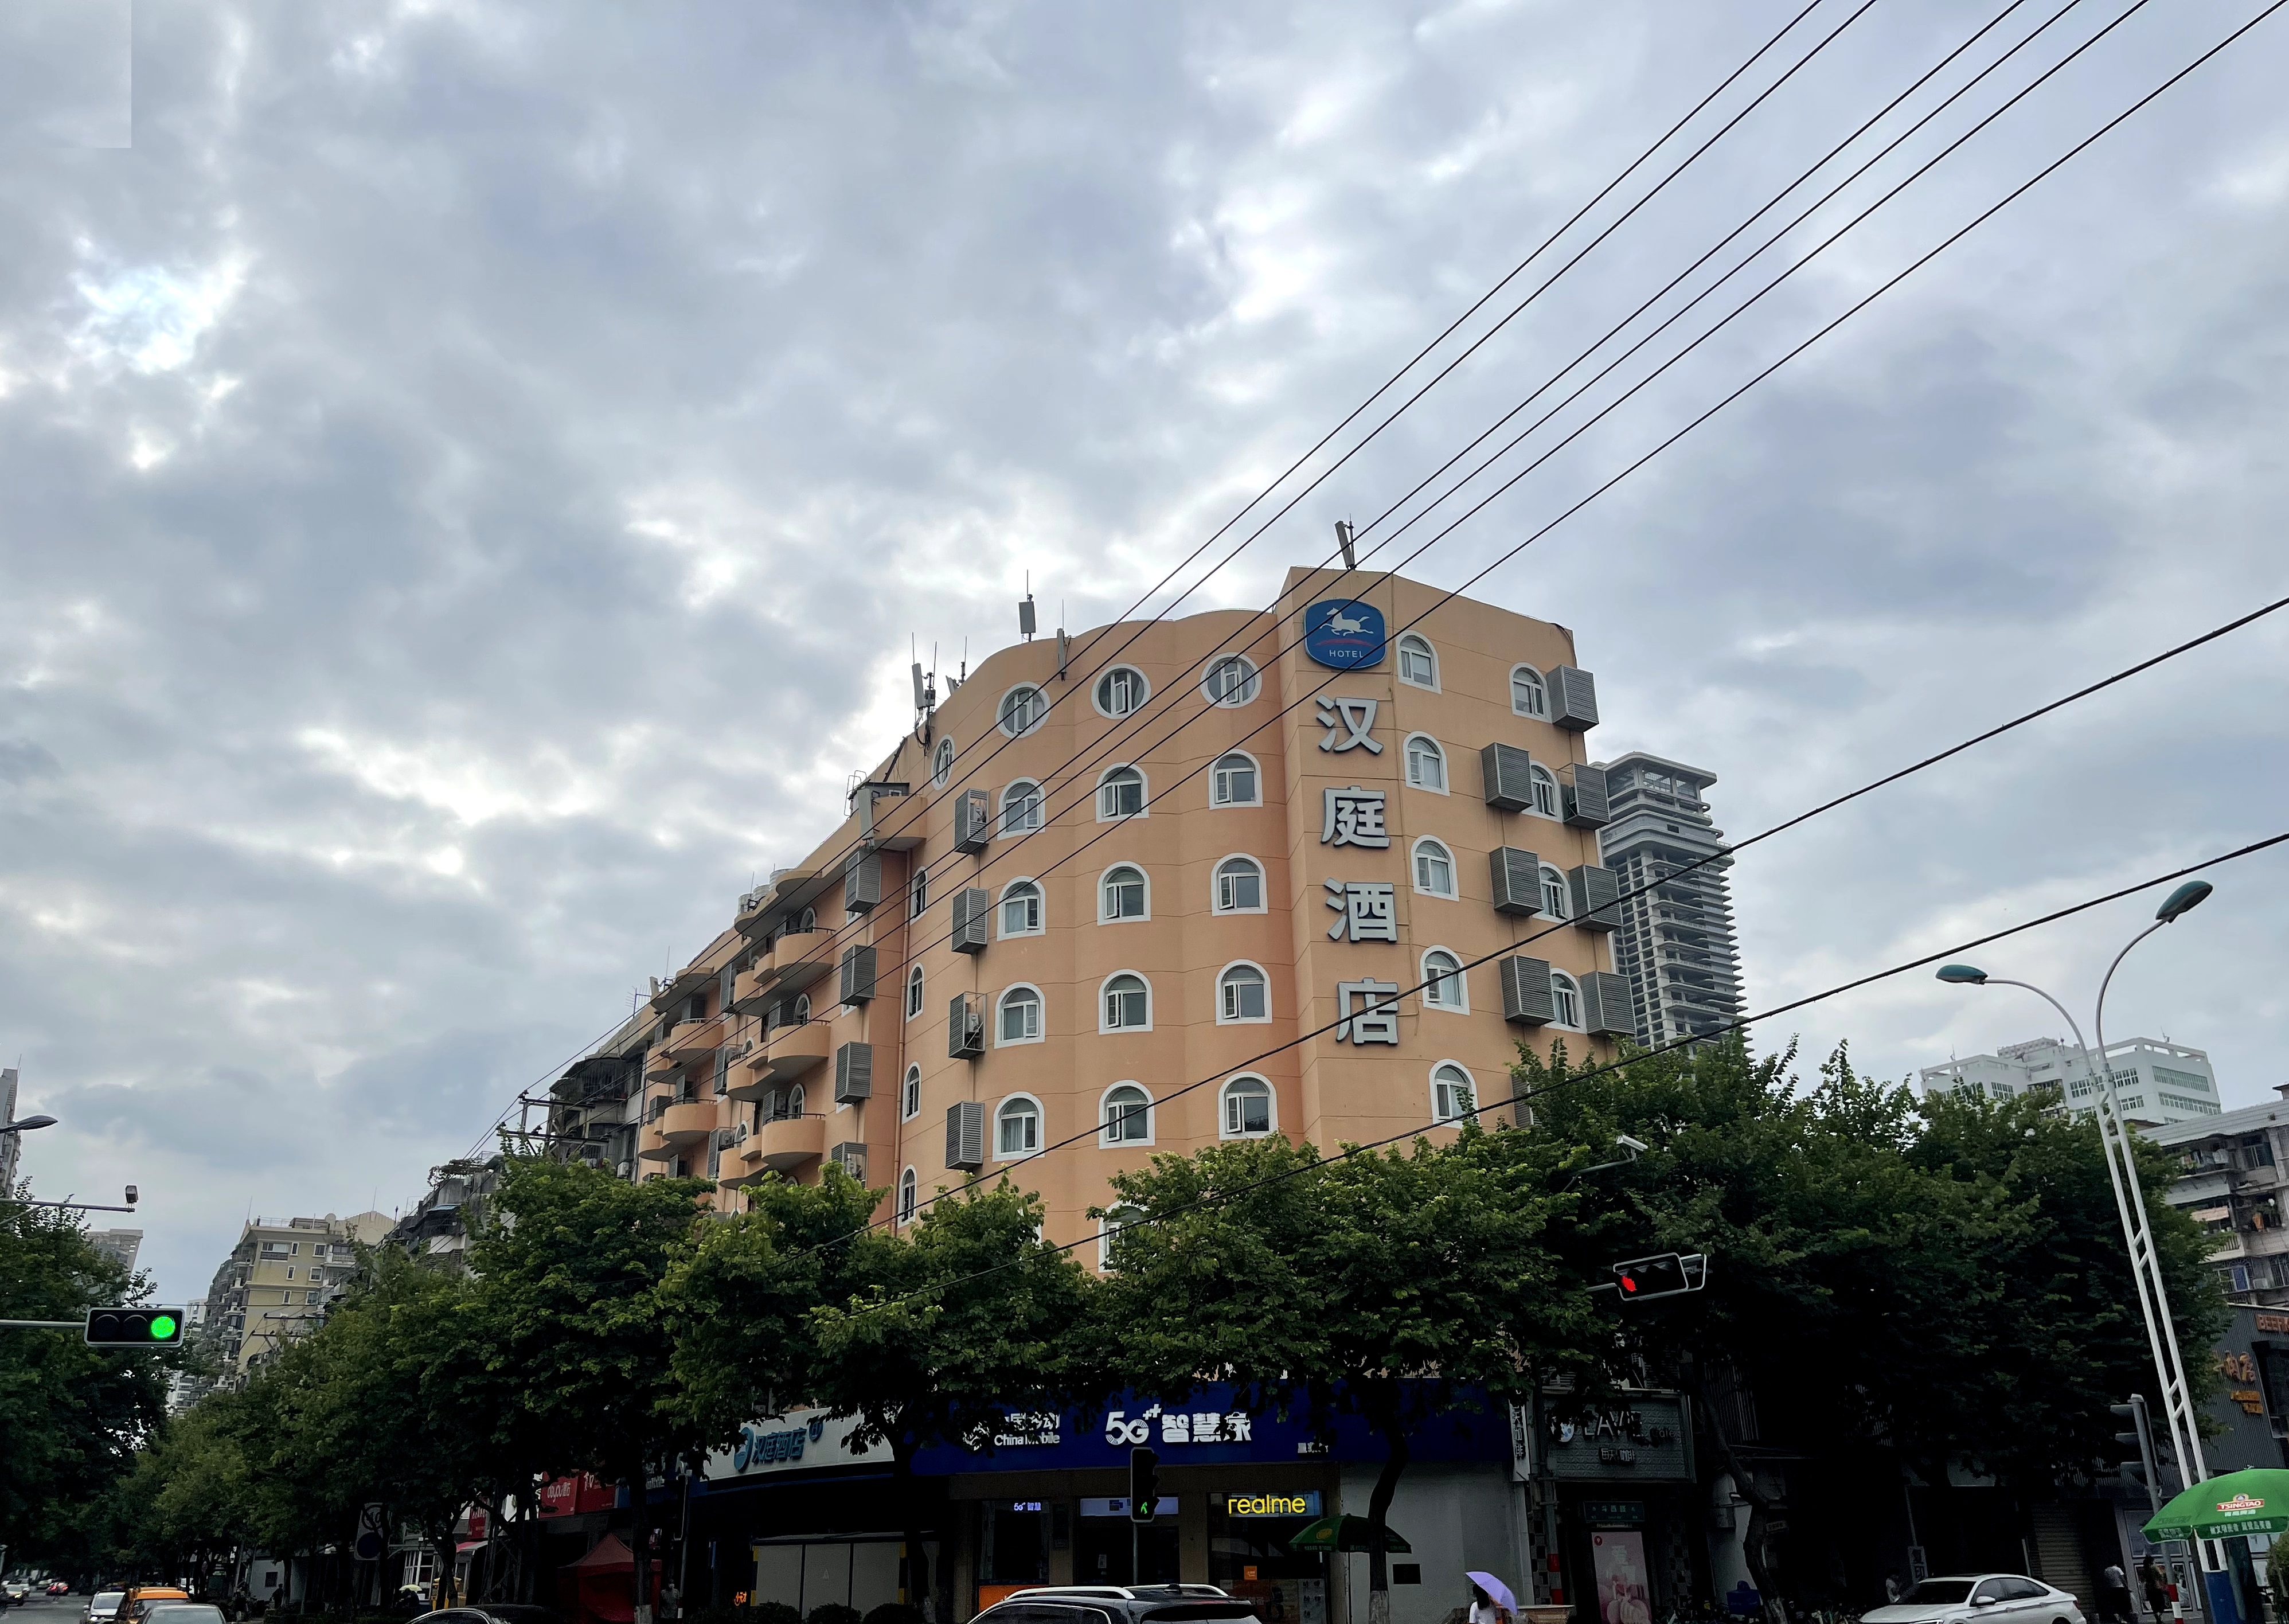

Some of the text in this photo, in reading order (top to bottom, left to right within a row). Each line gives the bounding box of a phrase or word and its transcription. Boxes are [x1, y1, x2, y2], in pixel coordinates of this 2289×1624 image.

[1329, 649, 1364, 659] HOTEL
[1316, 694, 1399, 1045] 汉庭酒店
[752, 1427, 807, 1464] 汉庭酒店
[994, 1431, 1060, 1446] China Mbile
[1228, 1493, 1306, 1514] realme
[2220, 1500, 2261, 1510] TSINGTAO
